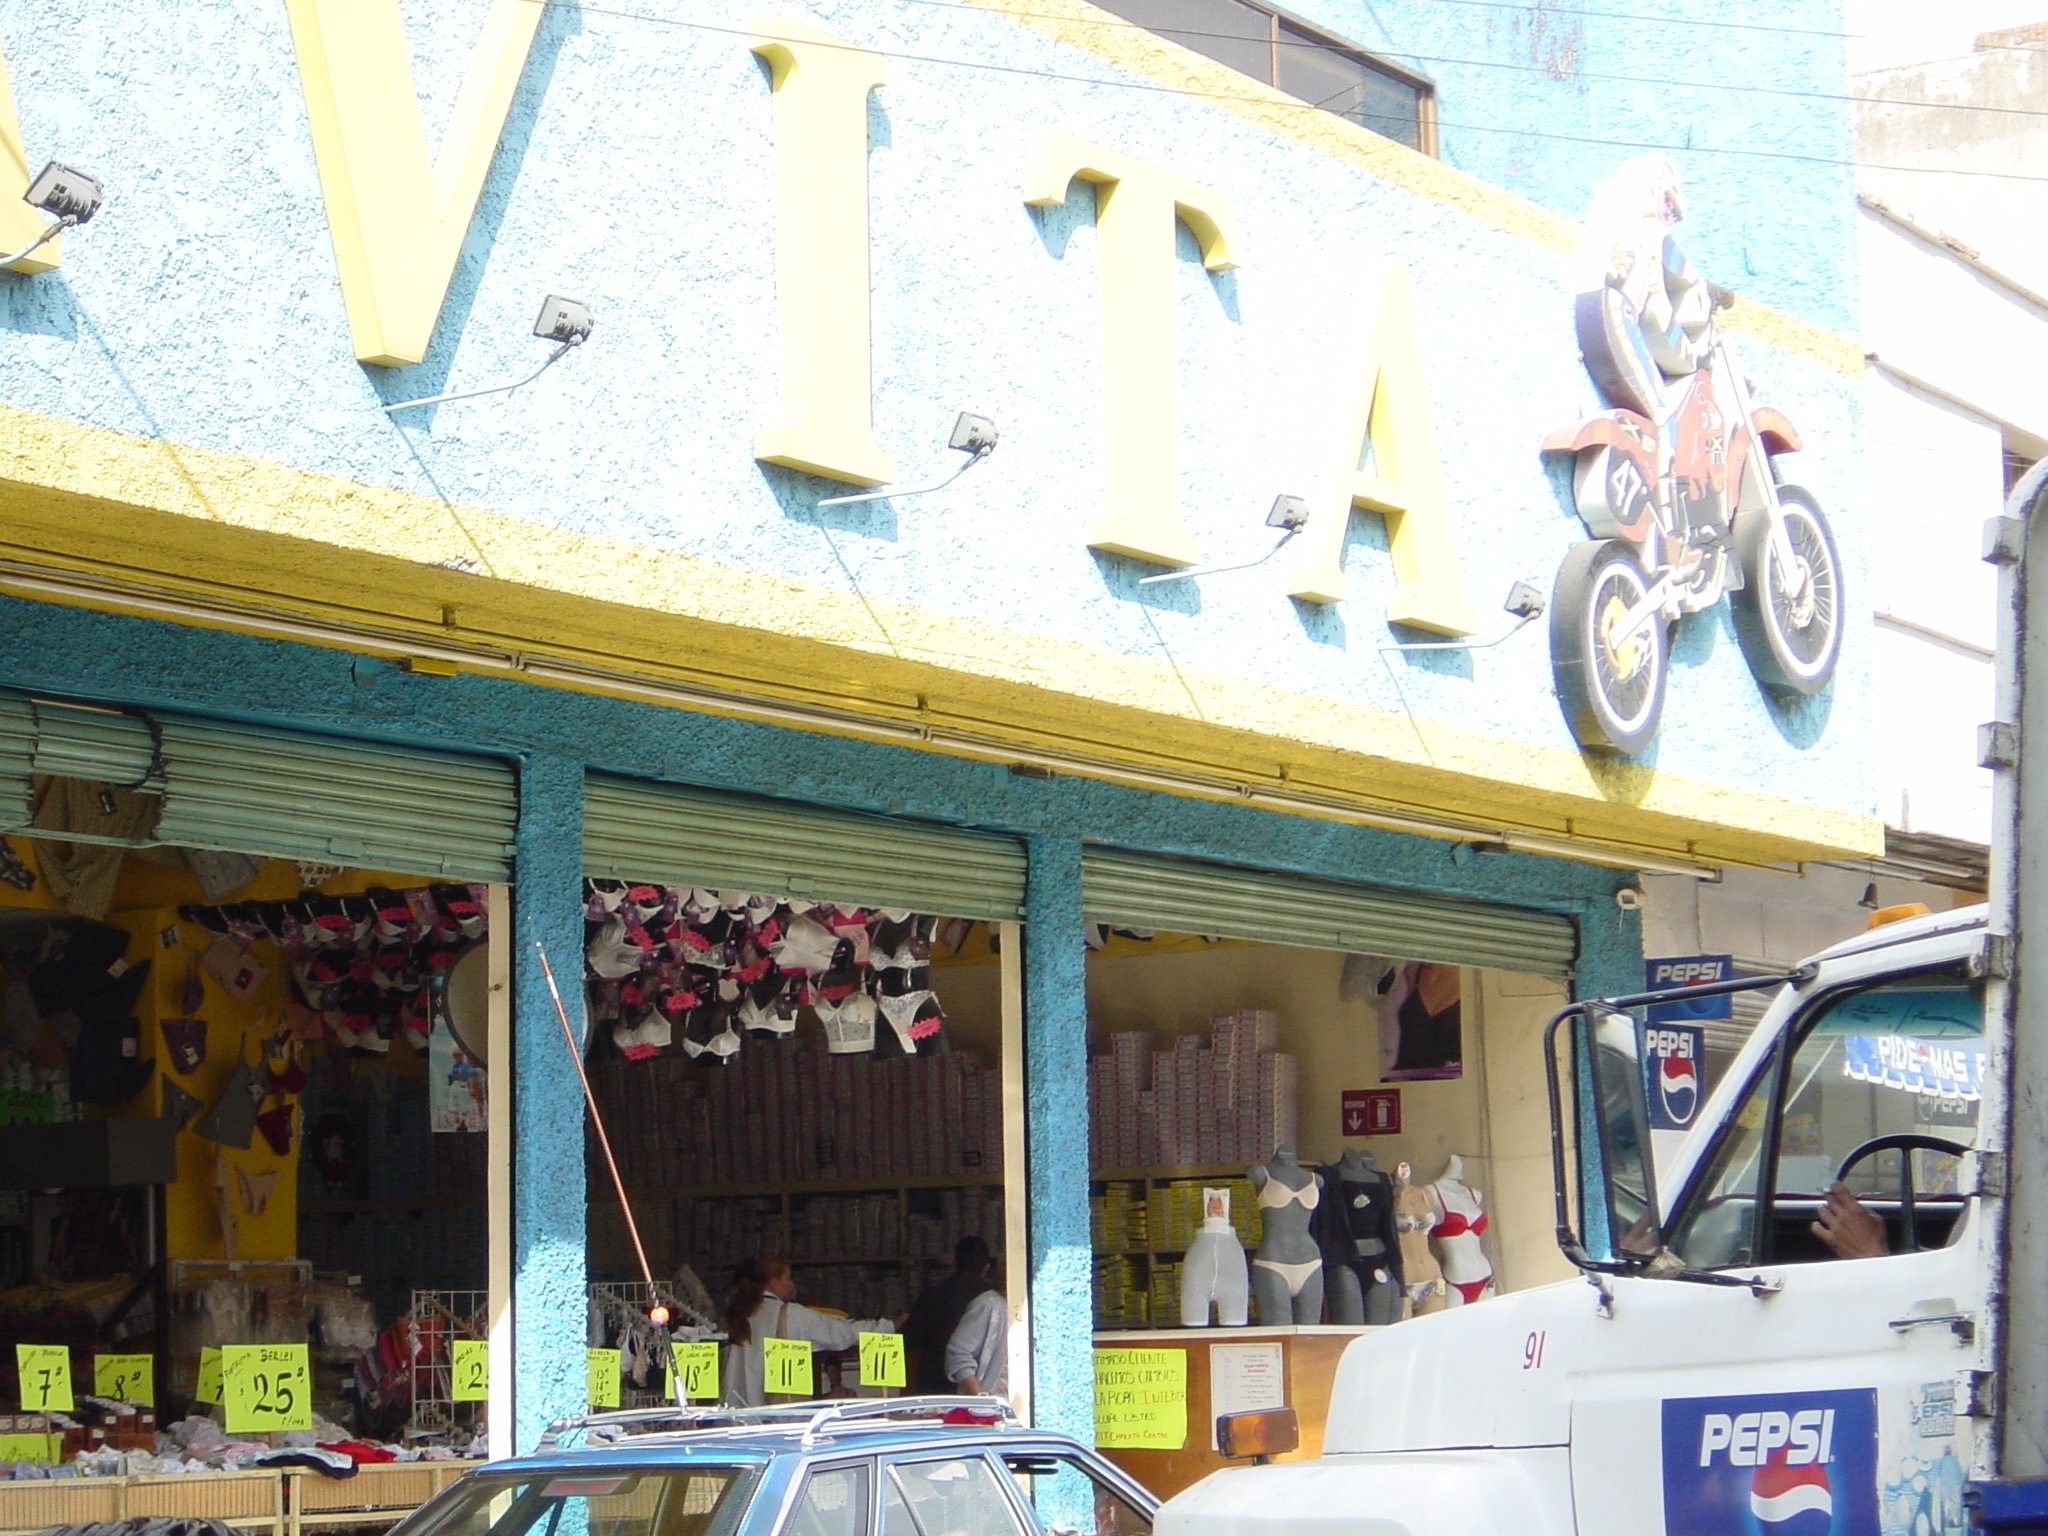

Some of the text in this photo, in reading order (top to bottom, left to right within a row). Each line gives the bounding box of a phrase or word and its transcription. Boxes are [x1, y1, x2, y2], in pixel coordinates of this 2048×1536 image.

[0, 0, 1477, 638] VITA
[1656, 962, 1723, 982] PEPSI
[1646, 1029, 1694, 1059] PEPSI
[1877, 1035, 1921, 1073] PIDE
[1523, 1330, 1546, 1370] 91
[37, 1368, 52, 1407] 7
[112, 1374, 126, 1400] 8
[252, 1372, 294, 1415] 25
[468, 1361, 489, 1390] 2
[685, 1364, 700, 1392] 18
[1700, 1409, 1835, 1467] PEPSI
